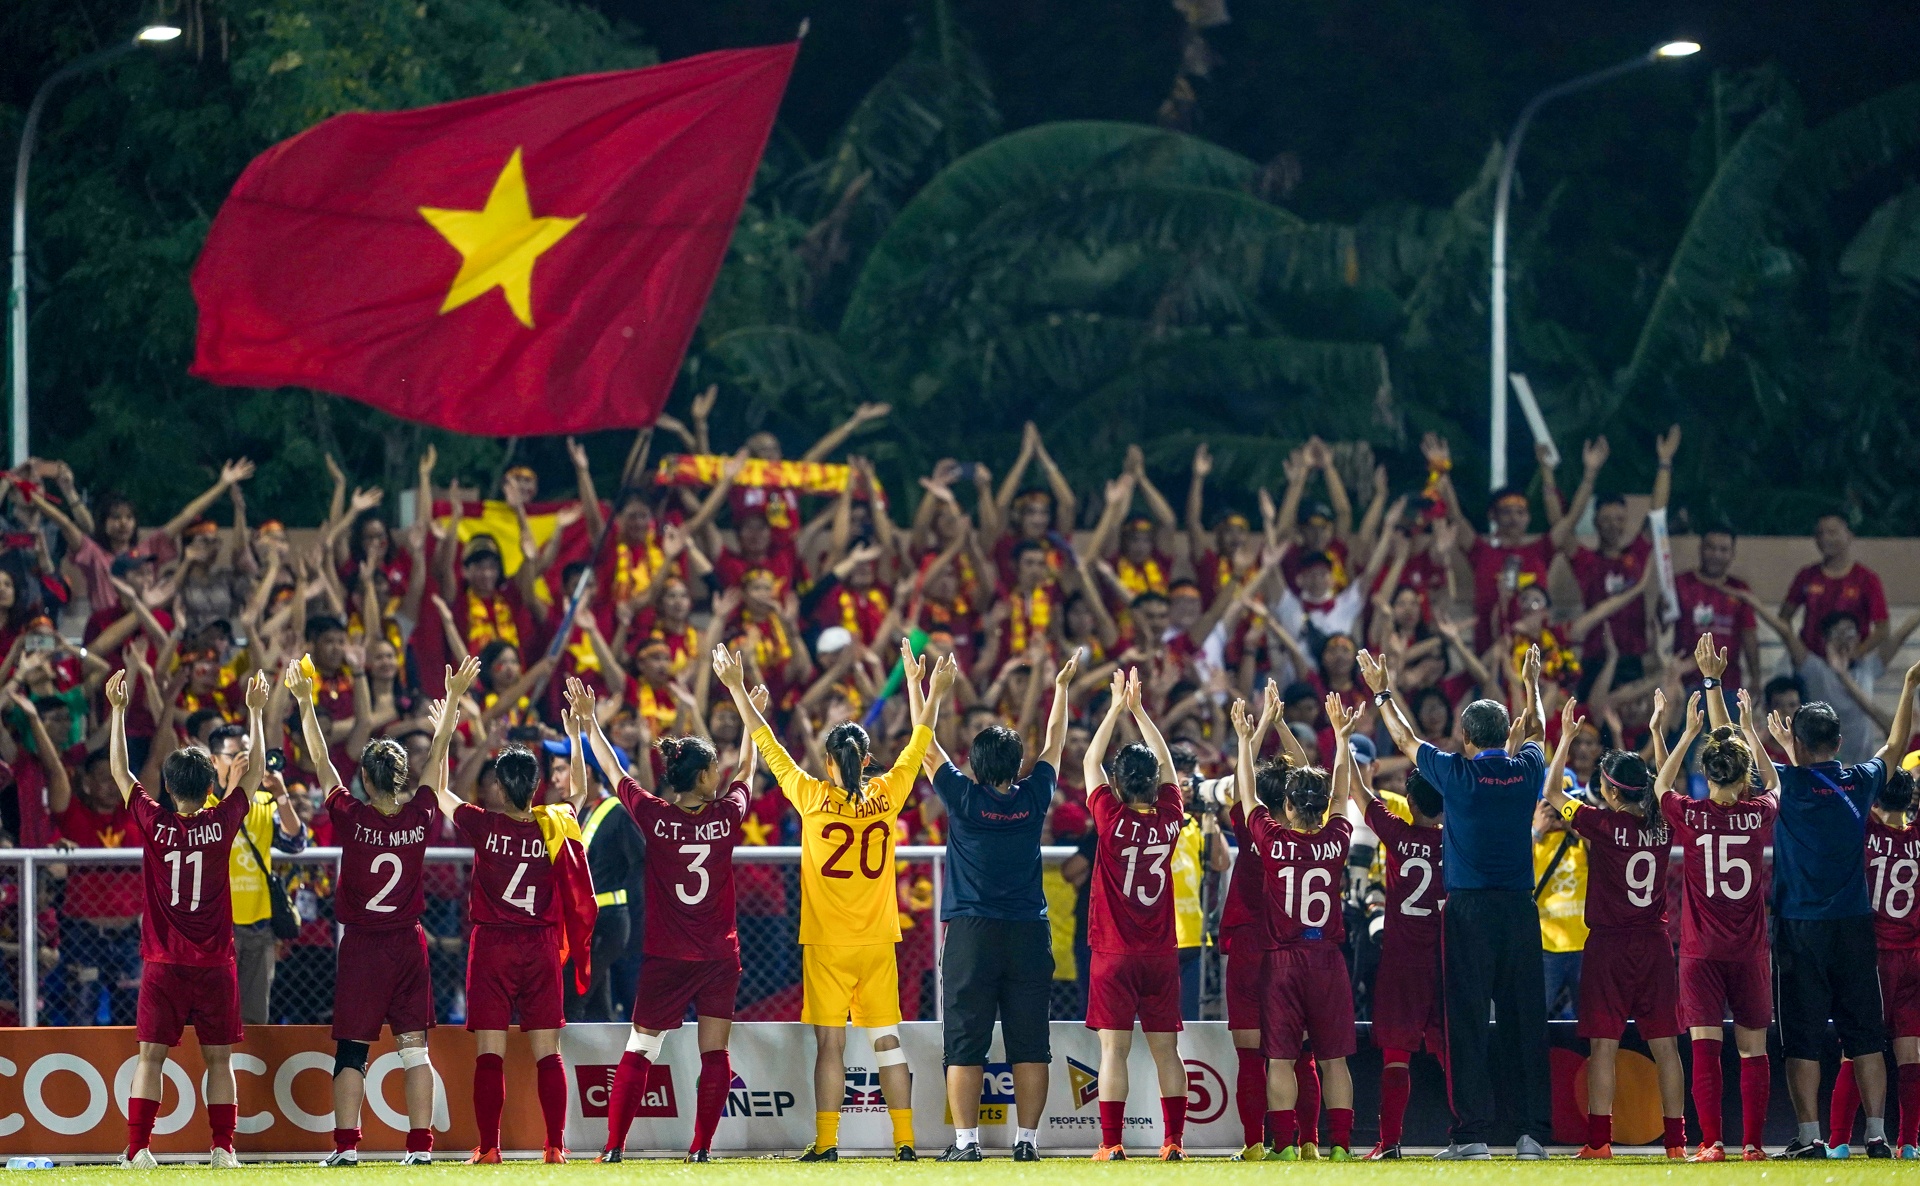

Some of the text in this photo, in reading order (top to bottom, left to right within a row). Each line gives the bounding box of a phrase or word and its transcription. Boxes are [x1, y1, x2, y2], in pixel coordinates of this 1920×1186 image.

[1478, 775, 1524, 786] VIETNAM
[855, 794, 890, 818] HANG
[981, 810, 1030, 821] VIETNAM
[654, 818, 731, 840] C.T. KIEU
[1685, 808, 1716, 830] P.T.
[154, 822, 223, 847] T.T. THAO
[354, 822, 425, 847] T.T.H. NHUNG
[485, 832, 513, 856] H.T.
[1614, 827, 1630, 847] H.
[1867, 833, 1899, 859] N.T.
[821, 820, 890, 880] 20
[1310, 840, 1342, 861] VAN
[675, 844, 711, 905] 3
[1120, 843, 1171, 907] 13
[1625, 850, 1657, 908] 9
[1695, 833, 1753, 900] 15
[164, 850, 203, 912] 11
[365, 852, 403, 913] 2
[501, 862, 536, 916] 4
[1399, 857, 1445, 917] 2
[1869, 855, 1919, 919] 18
[1278, 866, 1332, 928] 16
[586, 1085, 669, 1107] Cial
[981, 1071, 1015, 1096] ne
[1049, 1116, 1096, 1125] PEOPLE'S
